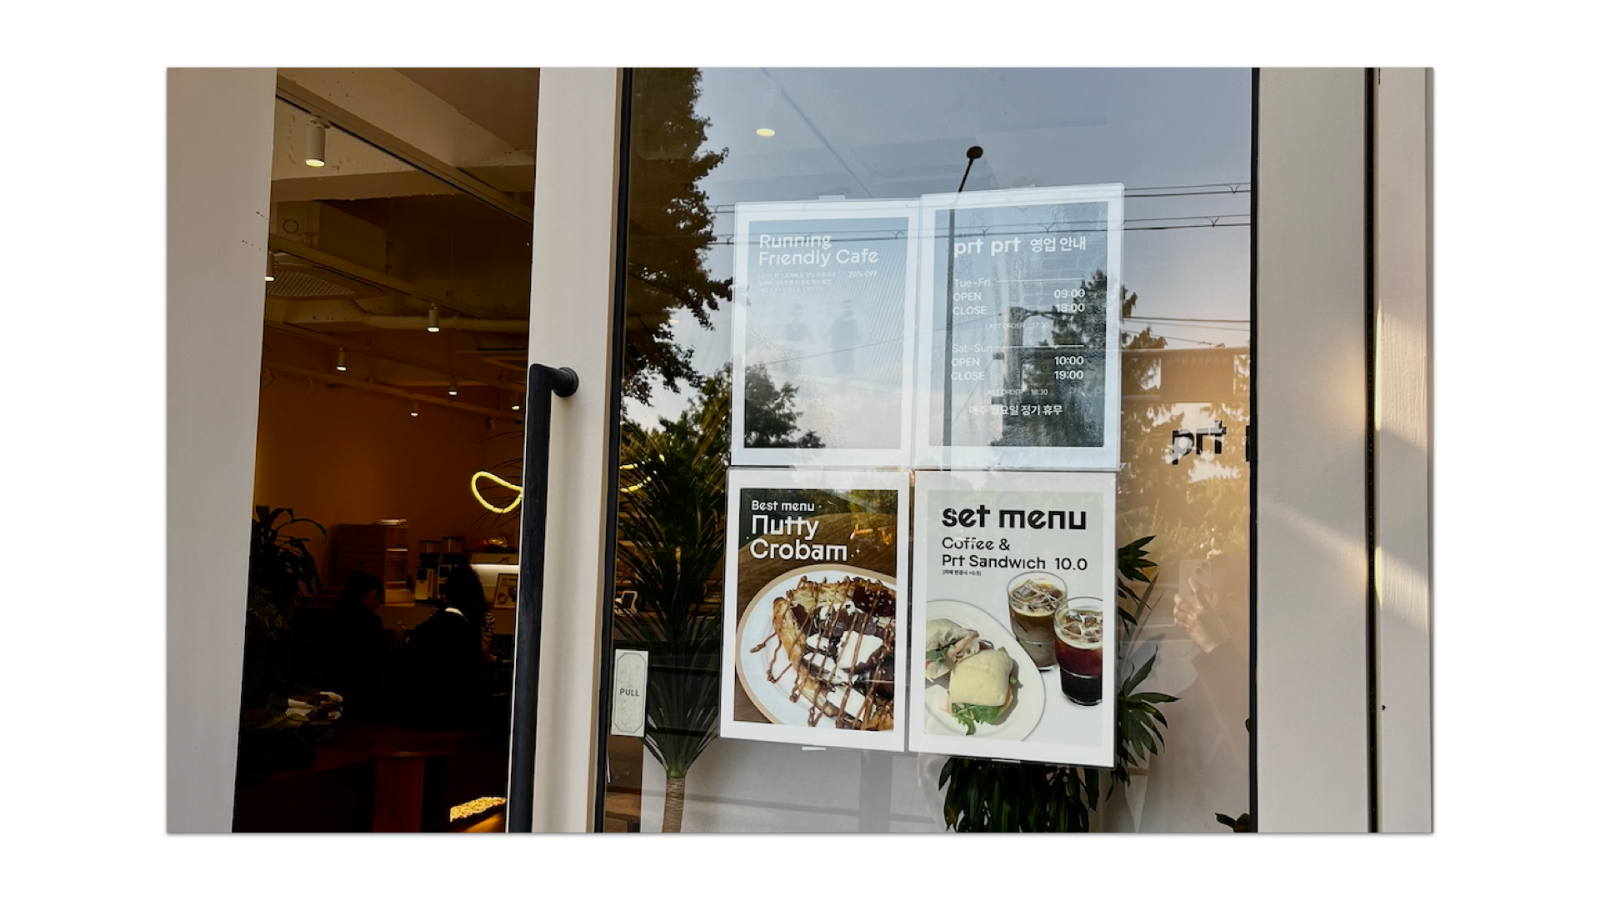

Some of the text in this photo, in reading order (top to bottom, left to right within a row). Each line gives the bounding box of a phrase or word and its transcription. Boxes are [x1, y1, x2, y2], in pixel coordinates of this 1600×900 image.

[759, 234, 832, 250] Running
[954, 236, 1086, 258] prt prt 영업 안내
[758, 248, 879, 267] Friendly Cafe
[864, 270, 878, 278] OFF
[954, 278, 991, 288] Tue-Fri
[953, 289, 1086, 301] OPEN 09:00
[952, 303, 1086, 315] CLOSE 18:00
[952, 344, 993, 353] Sat-Sun
[951, 356, 1084, 367] OPEN 10:00
[951, 371, 1084, 381] CLOSE 19:00
[990, 404, 1019, 416] 월요일
[1020, 404, 1041, 416] 정기
[1042, 404, 1063, 416] 휴무
[1172, 420, 1227, 465] prt
[751, 500, 815, 512] Best menu
[941, 504, 1086, 530] set menu
[941, 536, 1011, 551] Coffee &
[749, 538, 848, 562] Crobam
[942, 554, 1088, 571] Prt Sandwich 10.0
[619, 687, 640, 697] PULL
